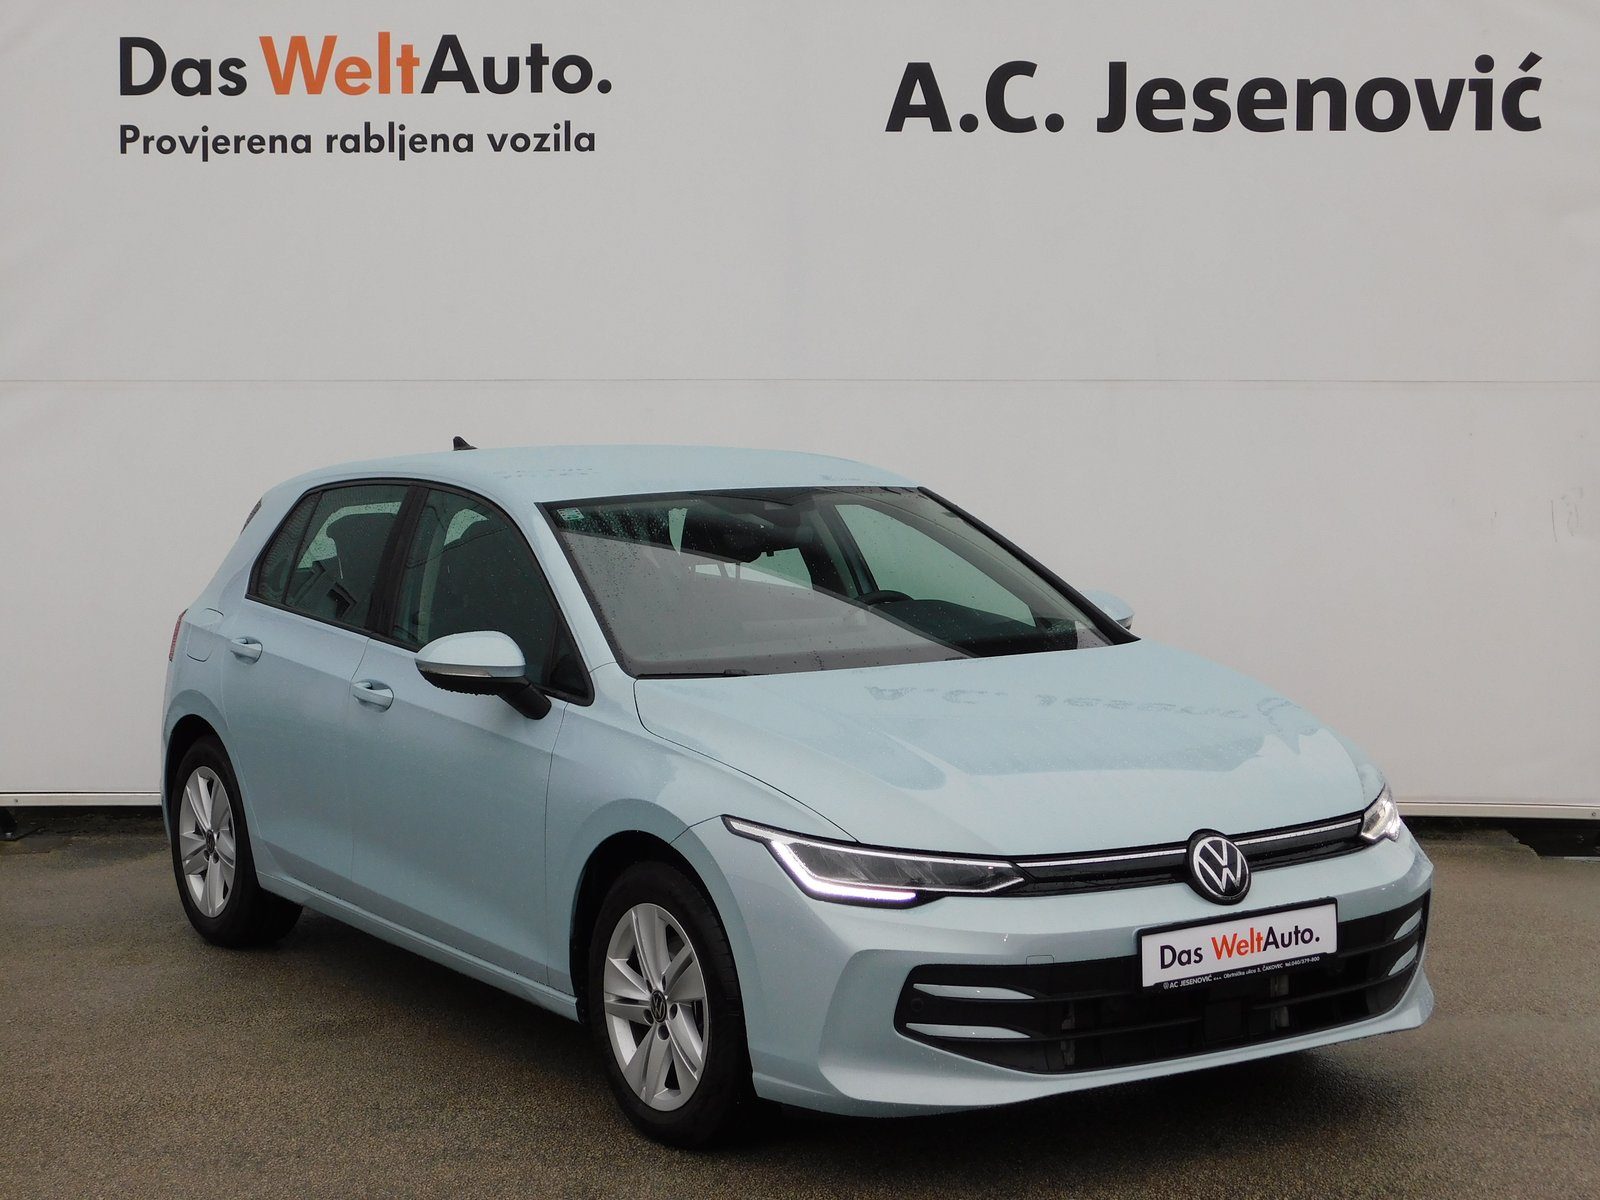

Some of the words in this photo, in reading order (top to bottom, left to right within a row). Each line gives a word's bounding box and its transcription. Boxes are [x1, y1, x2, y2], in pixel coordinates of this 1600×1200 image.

[119, 36, 248, 98] Das
[258, 31, 613, 96] WeltAuto.
[885, 60, 1065, 134] A.C.
[1096, 50, 1543, 134] Jesenović
[119, 124, 312, 163] Provjerena
[326, 120, 474, 162] rabljena
[486, 119, 596, 153] vozila
[1160, 944, 1204, 969] Das
[1211, 925, 1320, 960] WeltAuto.
[1169, 981, 1179, 989] AC
[1179, 974, 1213, 987] JESENOVIĆ
